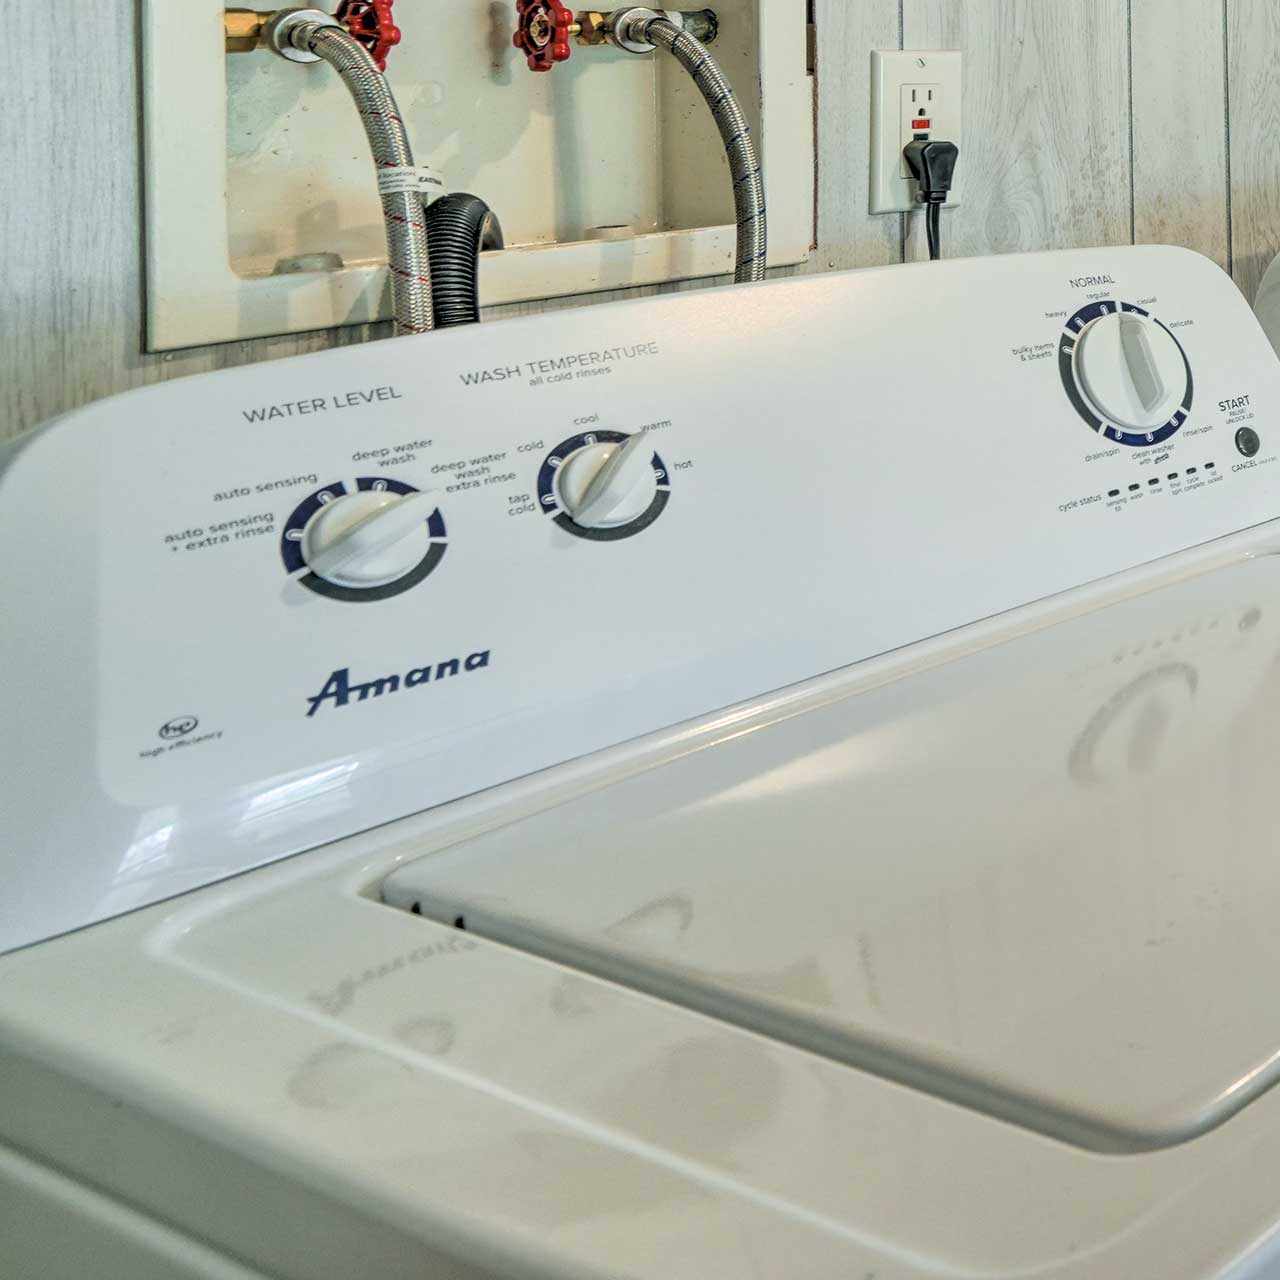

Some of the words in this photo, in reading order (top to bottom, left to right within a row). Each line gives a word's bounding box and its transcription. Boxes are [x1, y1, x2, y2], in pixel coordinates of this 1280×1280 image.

[1069, 274, 1116, 288] NORMAL
[1086, 290, 1111, 301] regular
[1136, 296, 1157, 306] casual
[1045, 310, 1068, 320] heavy
[1169, 319, 1195, 329] delicate
[1012, 344, 1033, 357] bulky
[1033, 342, 1055, 352] items
[1020, 353, 1027, 362] &
[1028, 350, 1052, 361] sheets
[459, 366, 521, 387] WASH
[526, 341, 659, 375] TEMPERATURE
[529, 376, 543, 387] all
[546, 370, 573, 384] cold
[575, 365, 612, 380] rinses
[242, 397, 327, 424] WATER
[333, 385, 403, 409] LEVEL
[1217, 395, 1251, 413] START
[573, 412, 600, 426] cool
[640, 418, 672, 433] warm
[1182, 424, 1215, 438] rinse/spin
[352, 446, 391, 463] deep
[393, 438, 434, 455] water
[517, 439, 545, 454] cold
[1131, 448, 1150, 460] clean
[1151, 442, 1175, 456] washer
[377, 452, 417, 468] wash
[1084, 447, 1121, 463] drain/spin
[430, 459, 467, 476] deep
[470, 451, 507, 468] water
[674, 458, 695, 472] hot
[1231, 459, 1258, 473] CANCEL
[454, 466, 491, 481] wash
[213, 486, 250, 503] auto
[256, 472, 319, 494] sensing
[445, 478, 480, 494] extra
[483, 470, 517, 485] rinse
[508, 493, 531, 506] tap
[1058, 498, 1078, 513] cycle
[1079, 493, 1102, 507] status
[508, 502, 537, 517] cold
[164, 529, 201, 545] auto
[208, 512, 275, 535] sensing
[185, 534, 230, 553] extra
[234, 523, 275, 542] rinse
[305, 648, 491, 718] Amana
